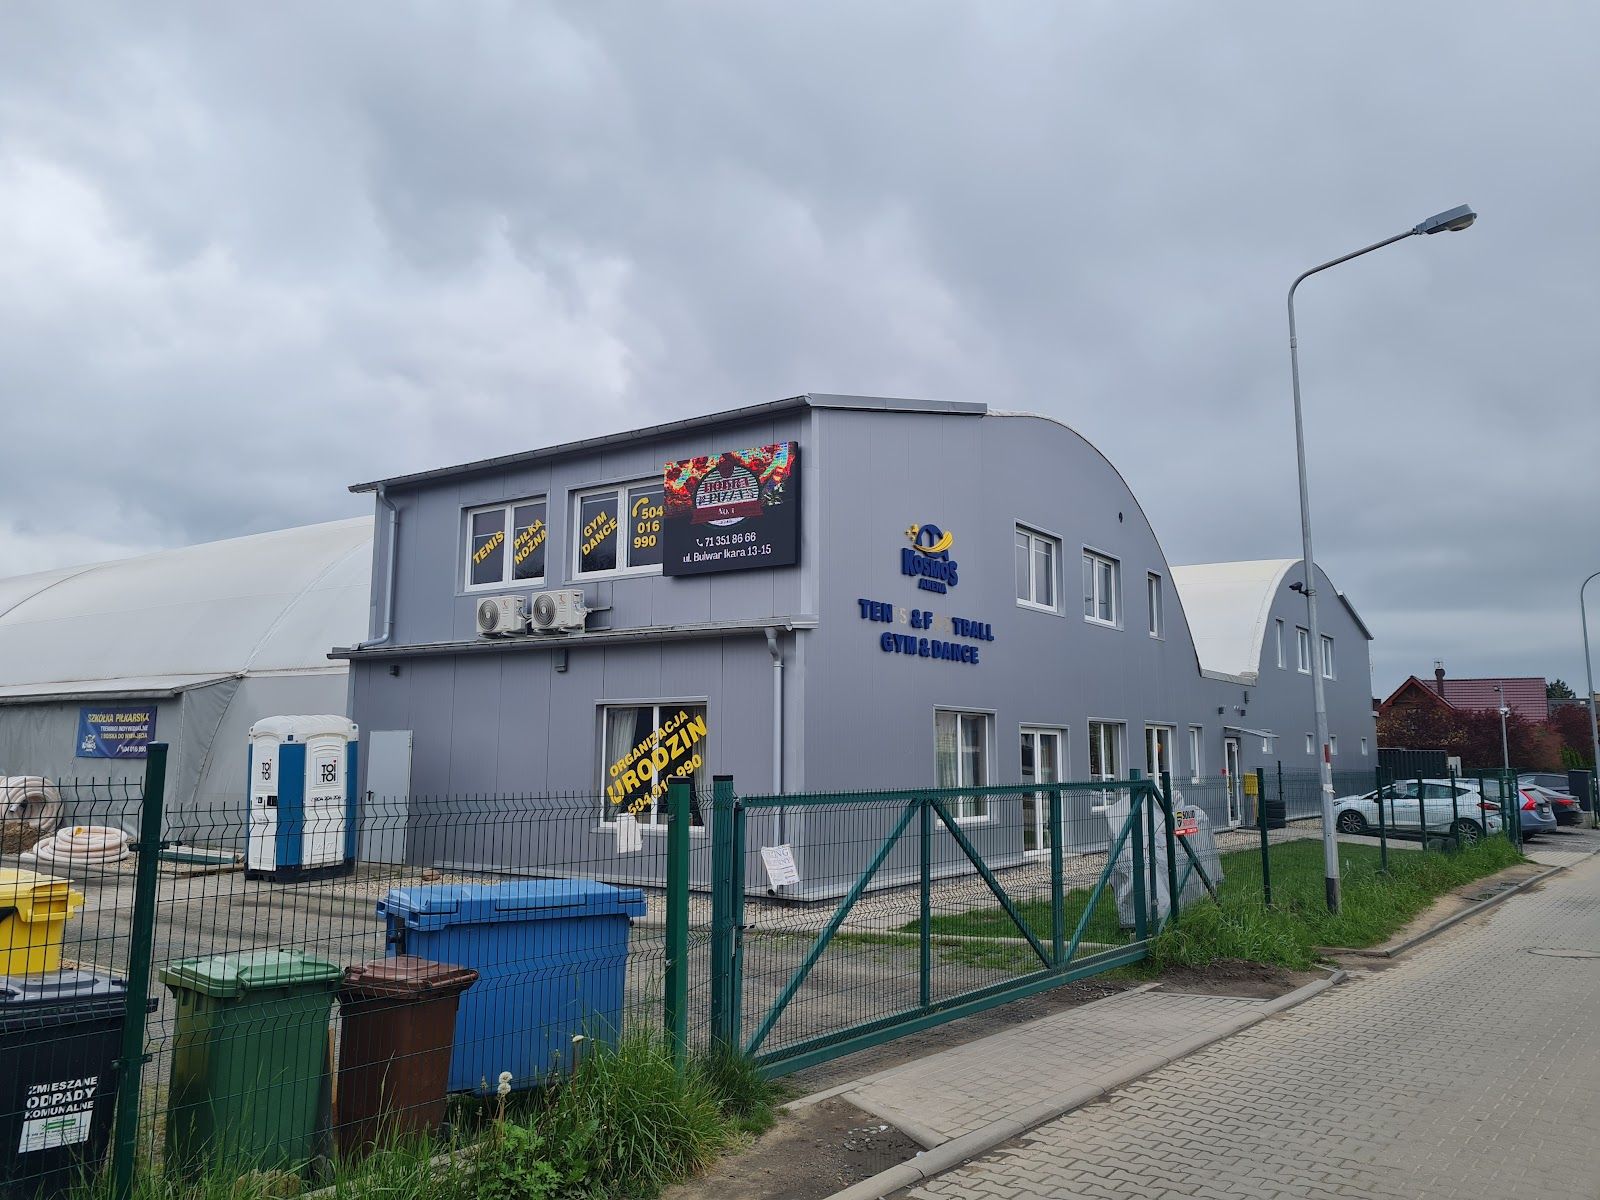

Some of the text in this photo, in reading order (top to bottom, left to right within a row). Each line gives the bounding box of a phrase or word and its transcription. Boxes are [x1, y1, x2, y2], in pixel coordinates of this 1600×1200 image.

[709, 489, 744, 504] PIZZA
[583, 511, 608, 537] GYM
[641, 505, 664, 520] 504
[514, 519, 543, 550] PIŁKA
[582, 517, 618, 556] DANCE
[637, 520, 660, 534] 016
[704, 531, 757, 547] 71 351 86 66
[473, 530, 504, 564] TENIS
[514, 529, 547, 565] NOŻNA
[633, 534, 657, 549] 990
[683, 543, 772, 563] ul. Bulwar Ikara 13-15
[902, 547, 959, 587] KOSMOS
[918, 578, 948, 594] ARENA
[923, 611, 994, 642] FTBALL
[880, 631, 918, 656] GYM
[931, 639, 980, 665] DANCE
[115, 713, 150, 723] PIŁKARSKA
[609, 710, 689, 778] ORGANIZACJA
[606, 714, 708, 805] URODZIN
[628, 753, 703, 816] 504 01 990
[26, 1086, 96, 1109] ODPADY
[27, 1076, 98, 1095] ZMIESZANE
[24, 1100, 94, 1120] KOMUNALNE
